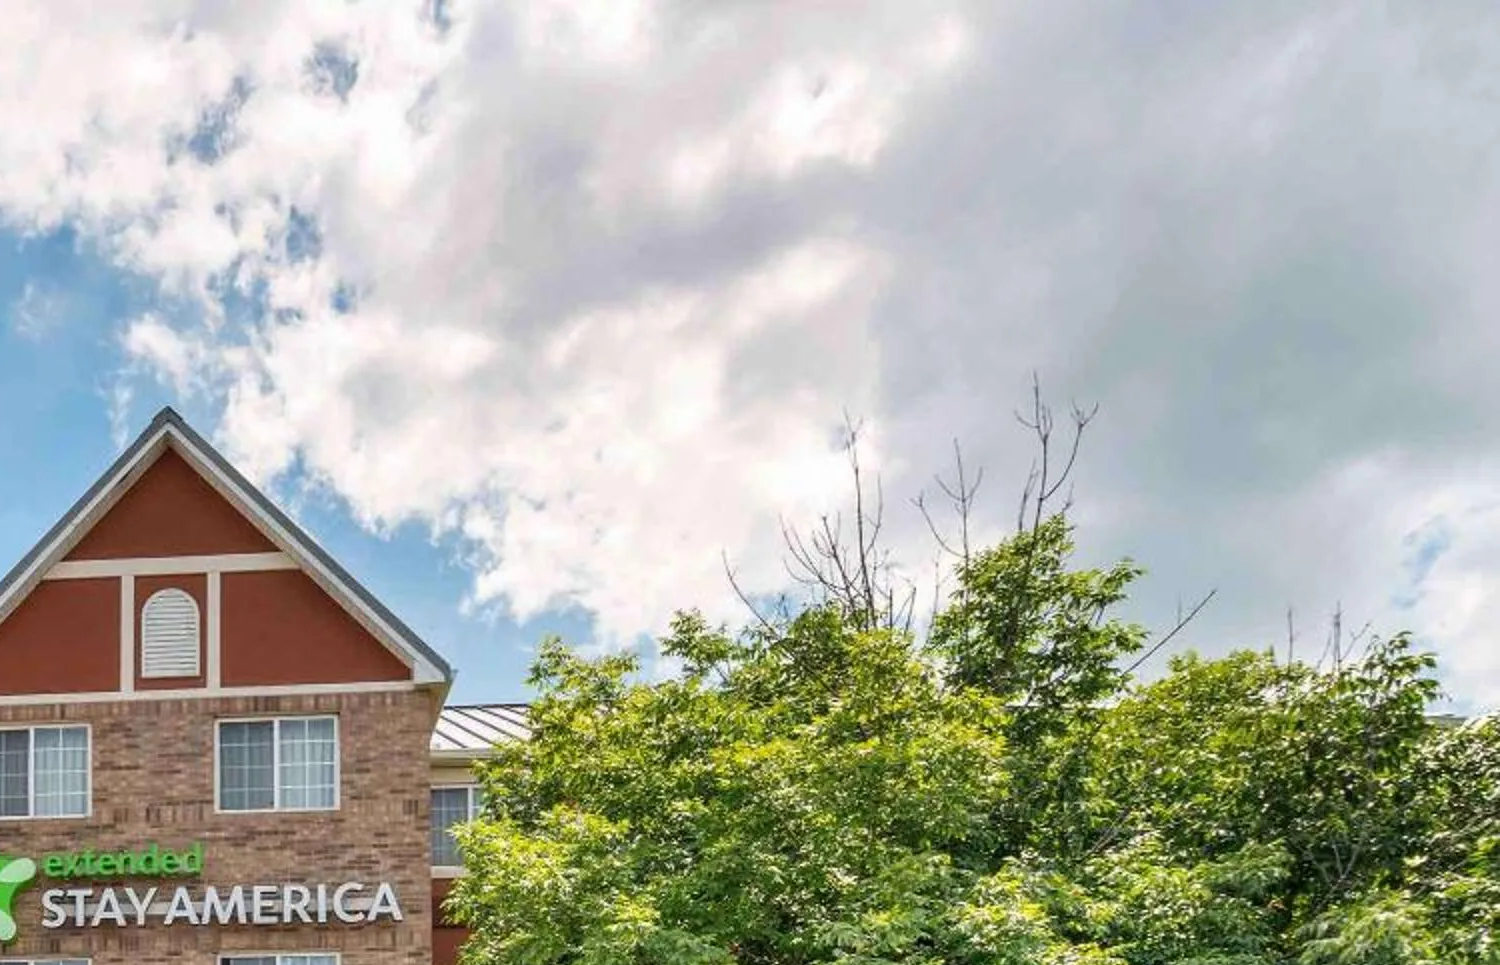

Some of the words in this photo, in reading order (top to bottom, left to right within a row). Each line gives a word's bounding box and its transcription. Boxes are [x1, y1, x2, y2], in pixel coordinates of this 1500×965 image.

[44, 841, 202, 877] extended
[42, 886, 158, 928] STAY
[164, 882, 404, 926] AMERICA
